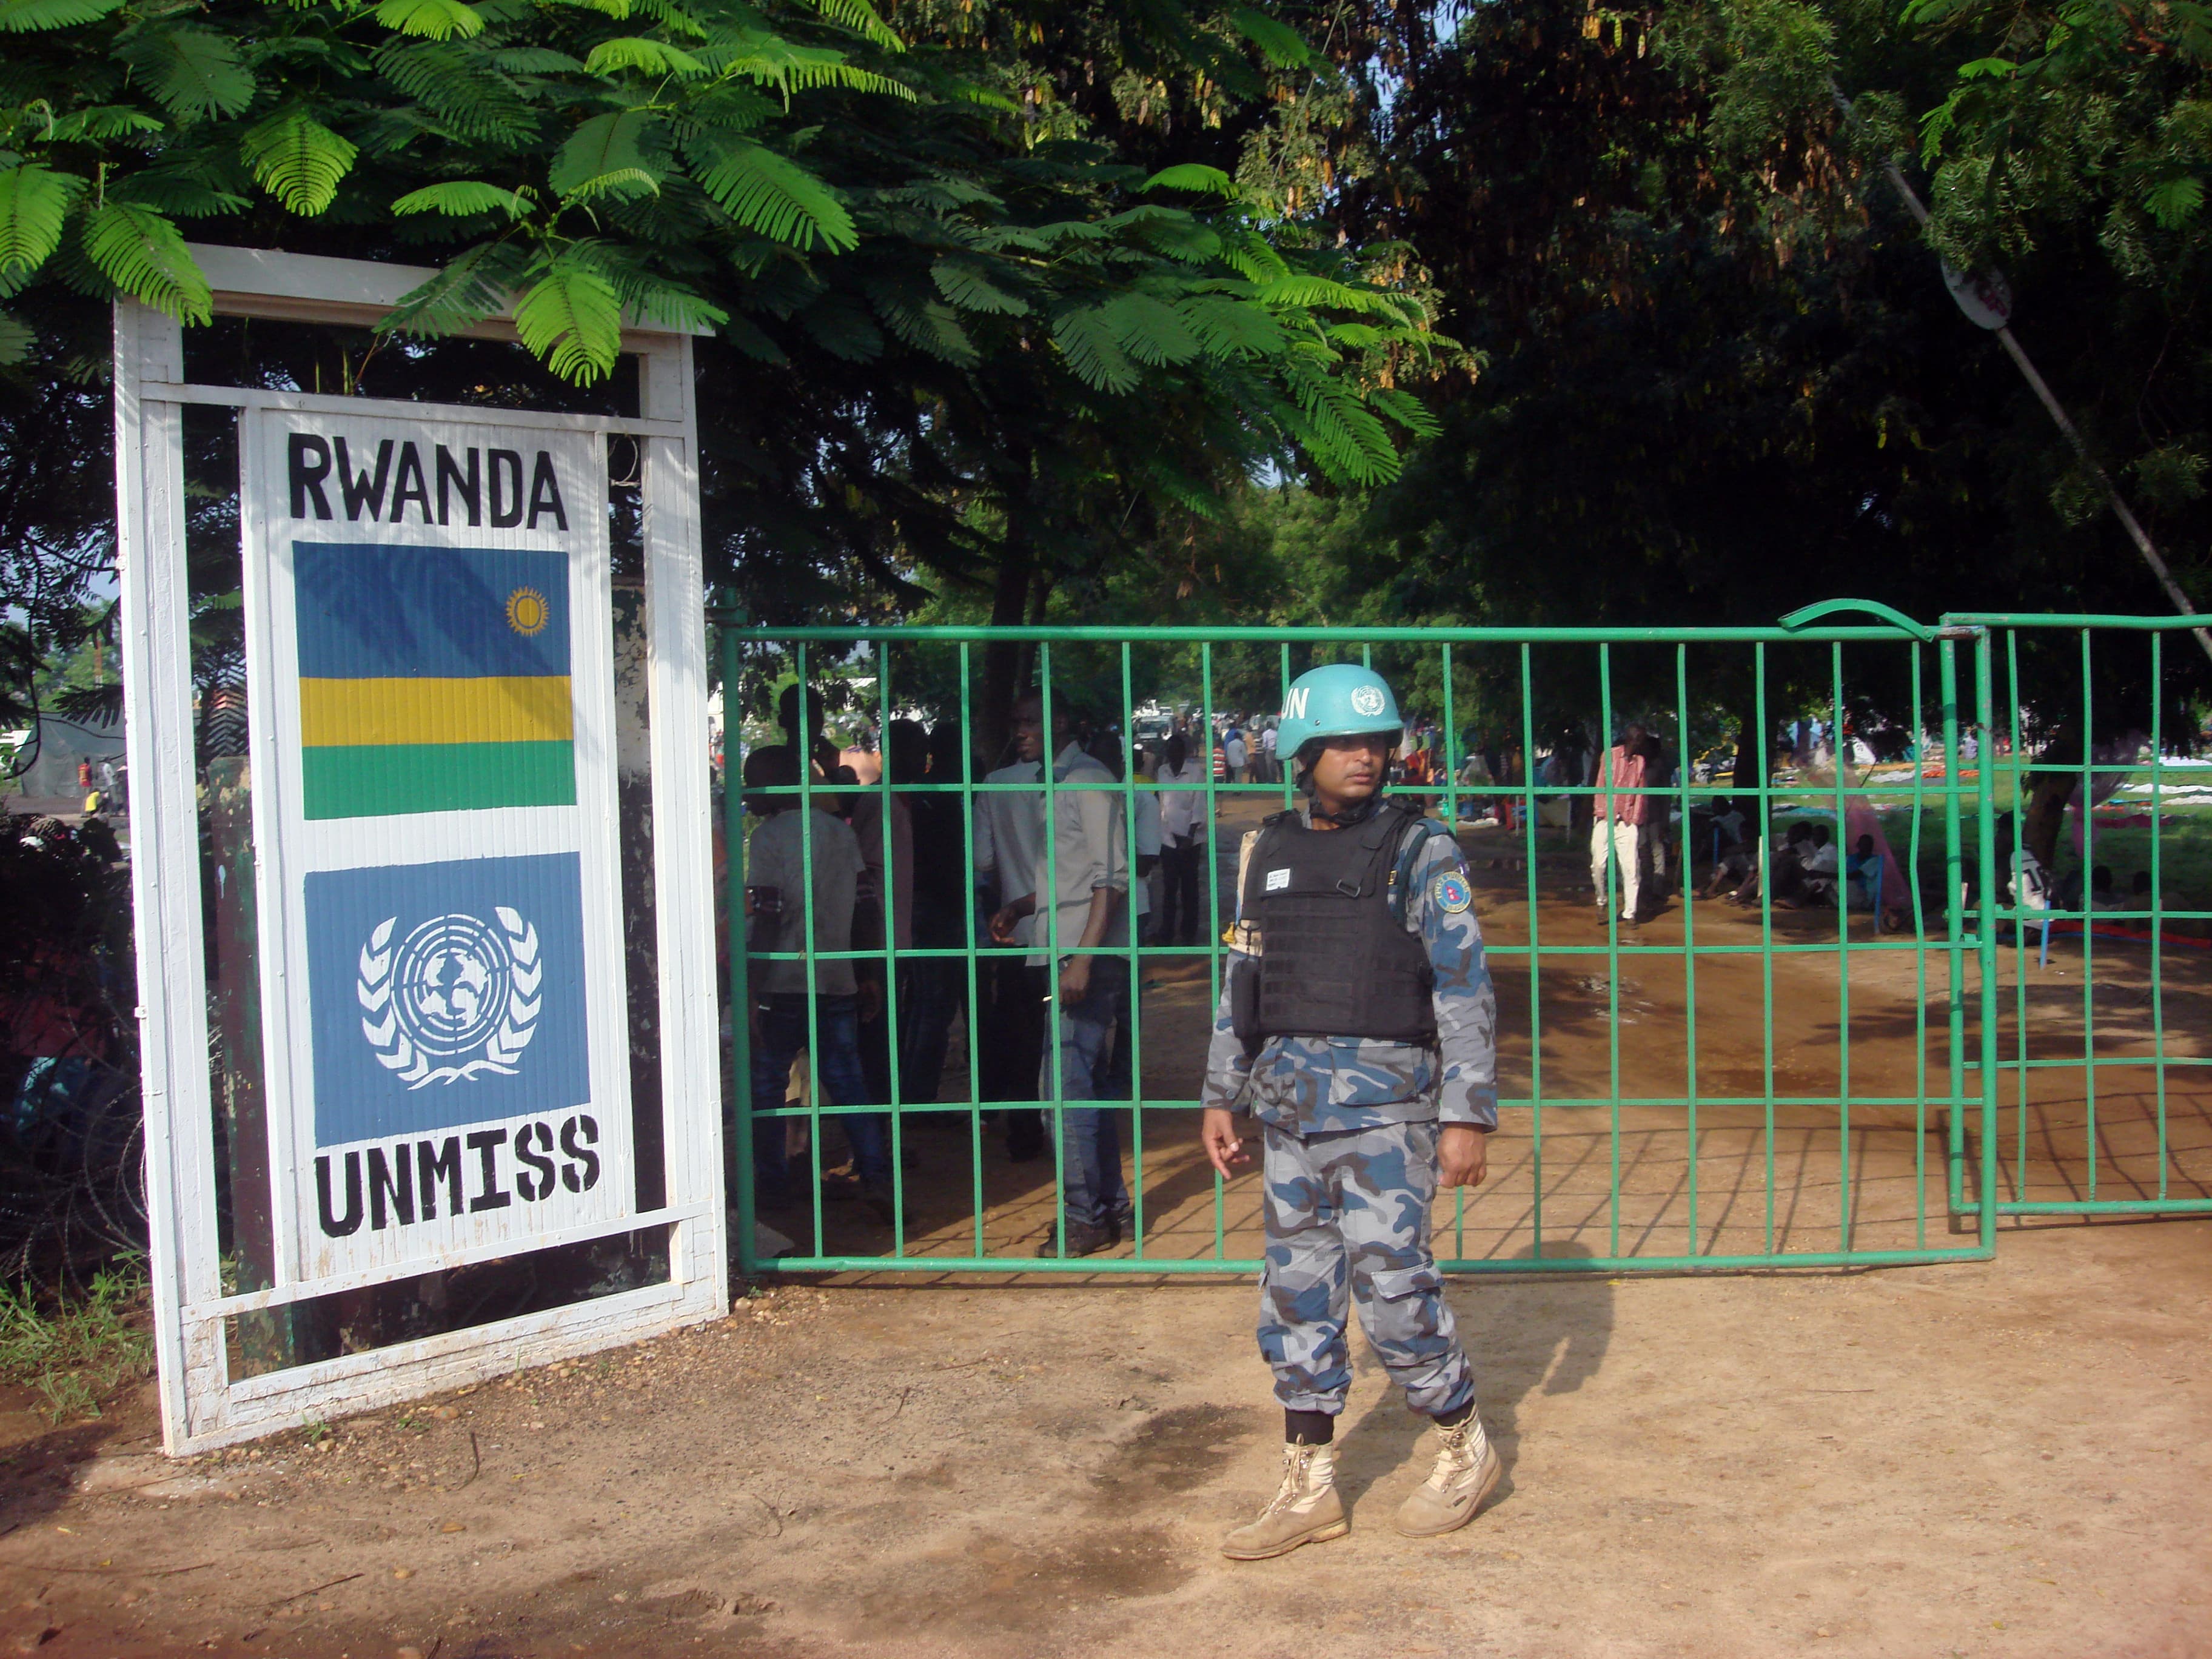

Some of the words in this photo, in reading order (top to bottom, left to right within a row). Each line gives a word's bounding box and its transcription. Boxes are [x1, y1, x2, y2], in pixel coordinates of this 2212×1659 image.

[288, 432, 569, 531] RWANDA
[1281, 688, 1310, 720] UN
[315, 1114, 600, 1238] UNMISS
